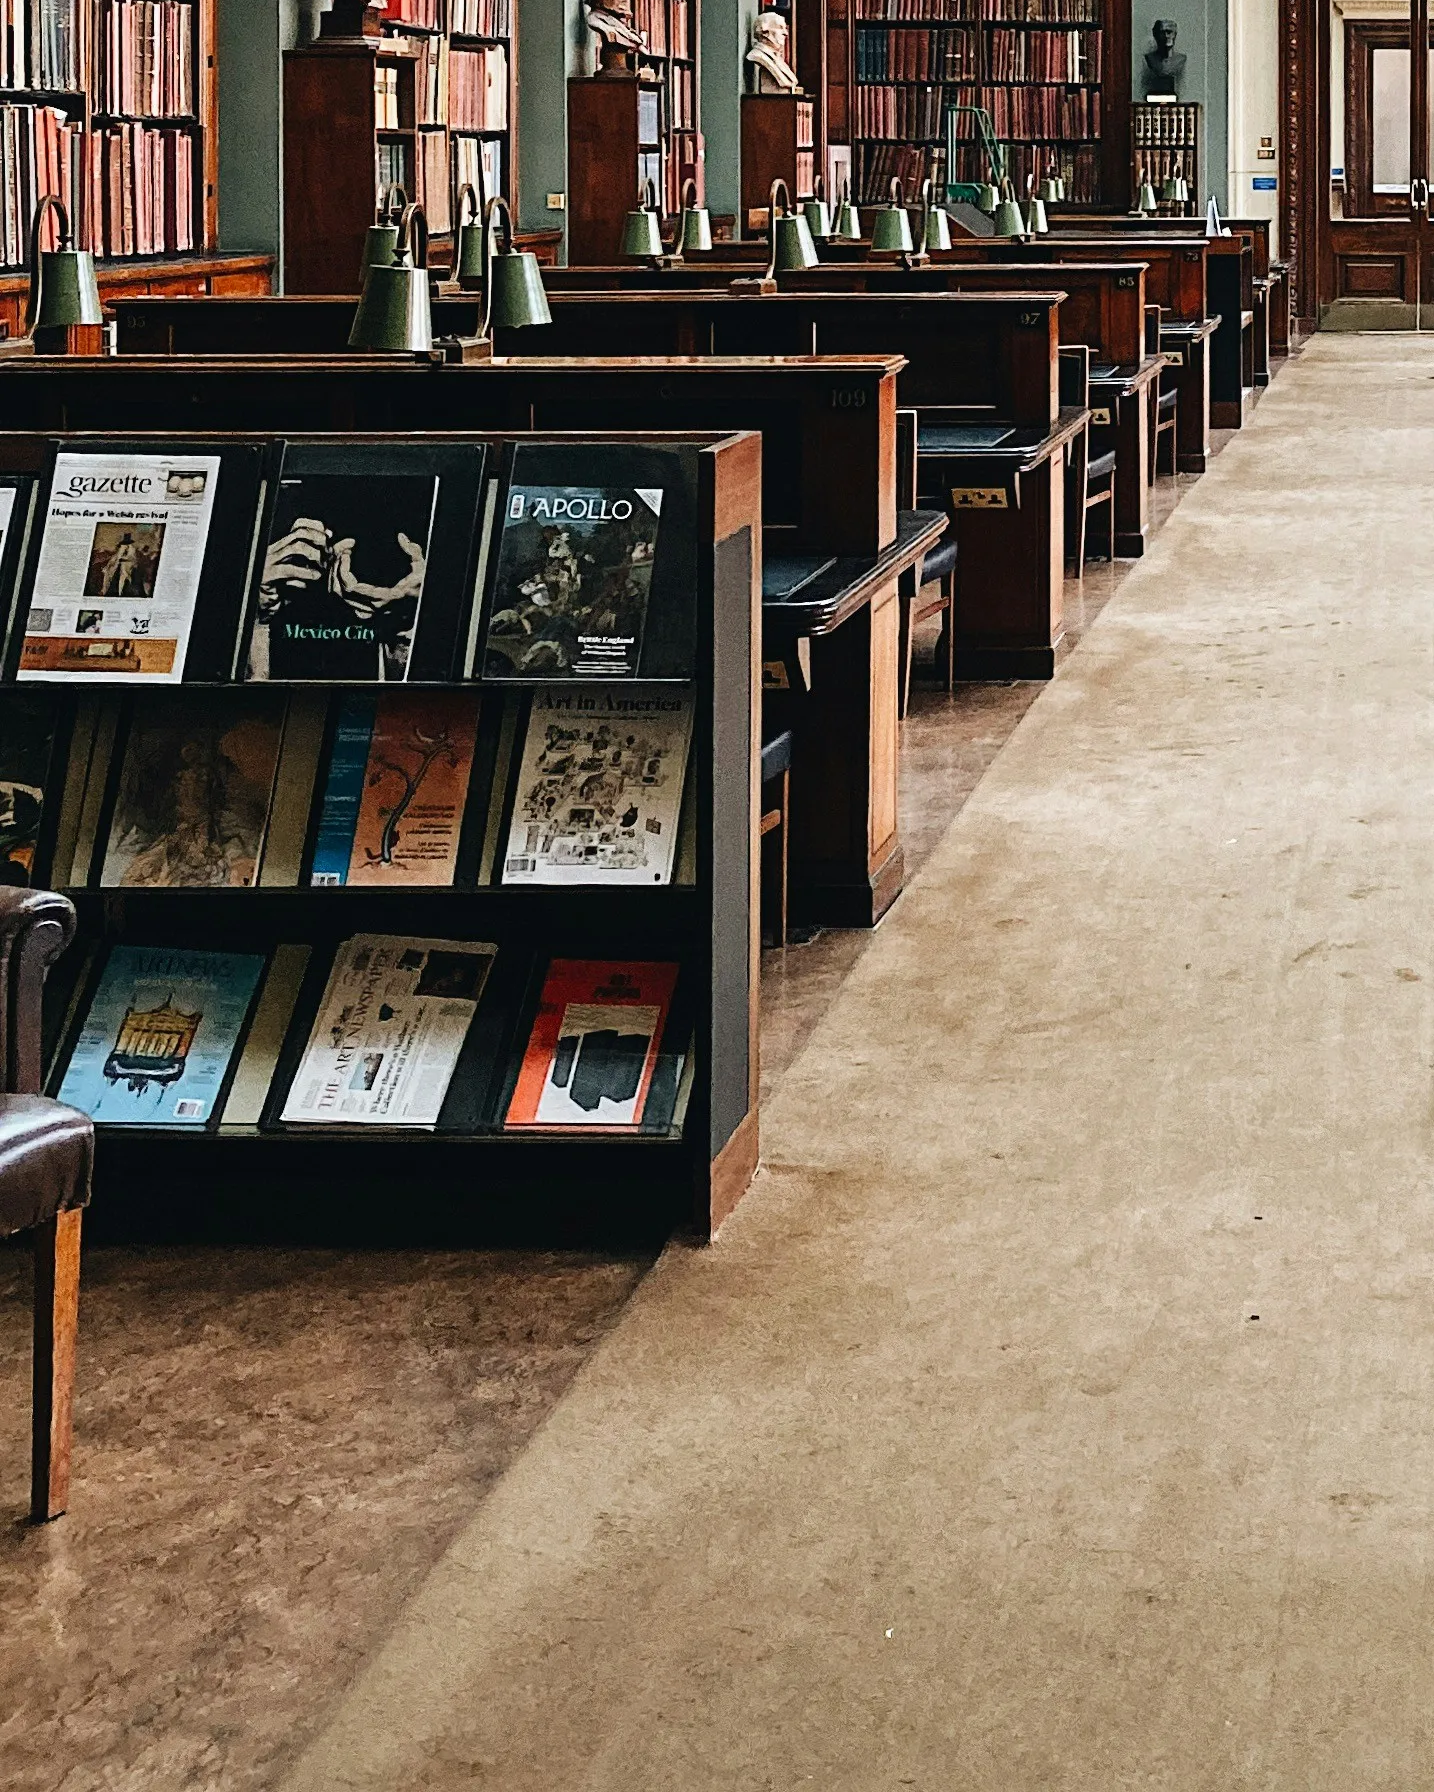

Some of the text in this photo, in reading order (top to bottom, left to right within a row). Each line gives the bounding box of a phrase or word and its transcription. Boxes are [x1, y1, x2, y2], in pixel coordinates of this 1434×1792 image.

[1020, 311, 1041, 325] 97
[831, 388, 866, 408] 109
[55, 475, 153, 498] gazette
[531, 497, 633, 520] APOLLO
[283, 624, 376, 644] Mexico City
[538, 692, 572, 710] Art
[601, 692, 682, 712] America
[317, 948, 389, 1110] THE ART NEWSPAPER
